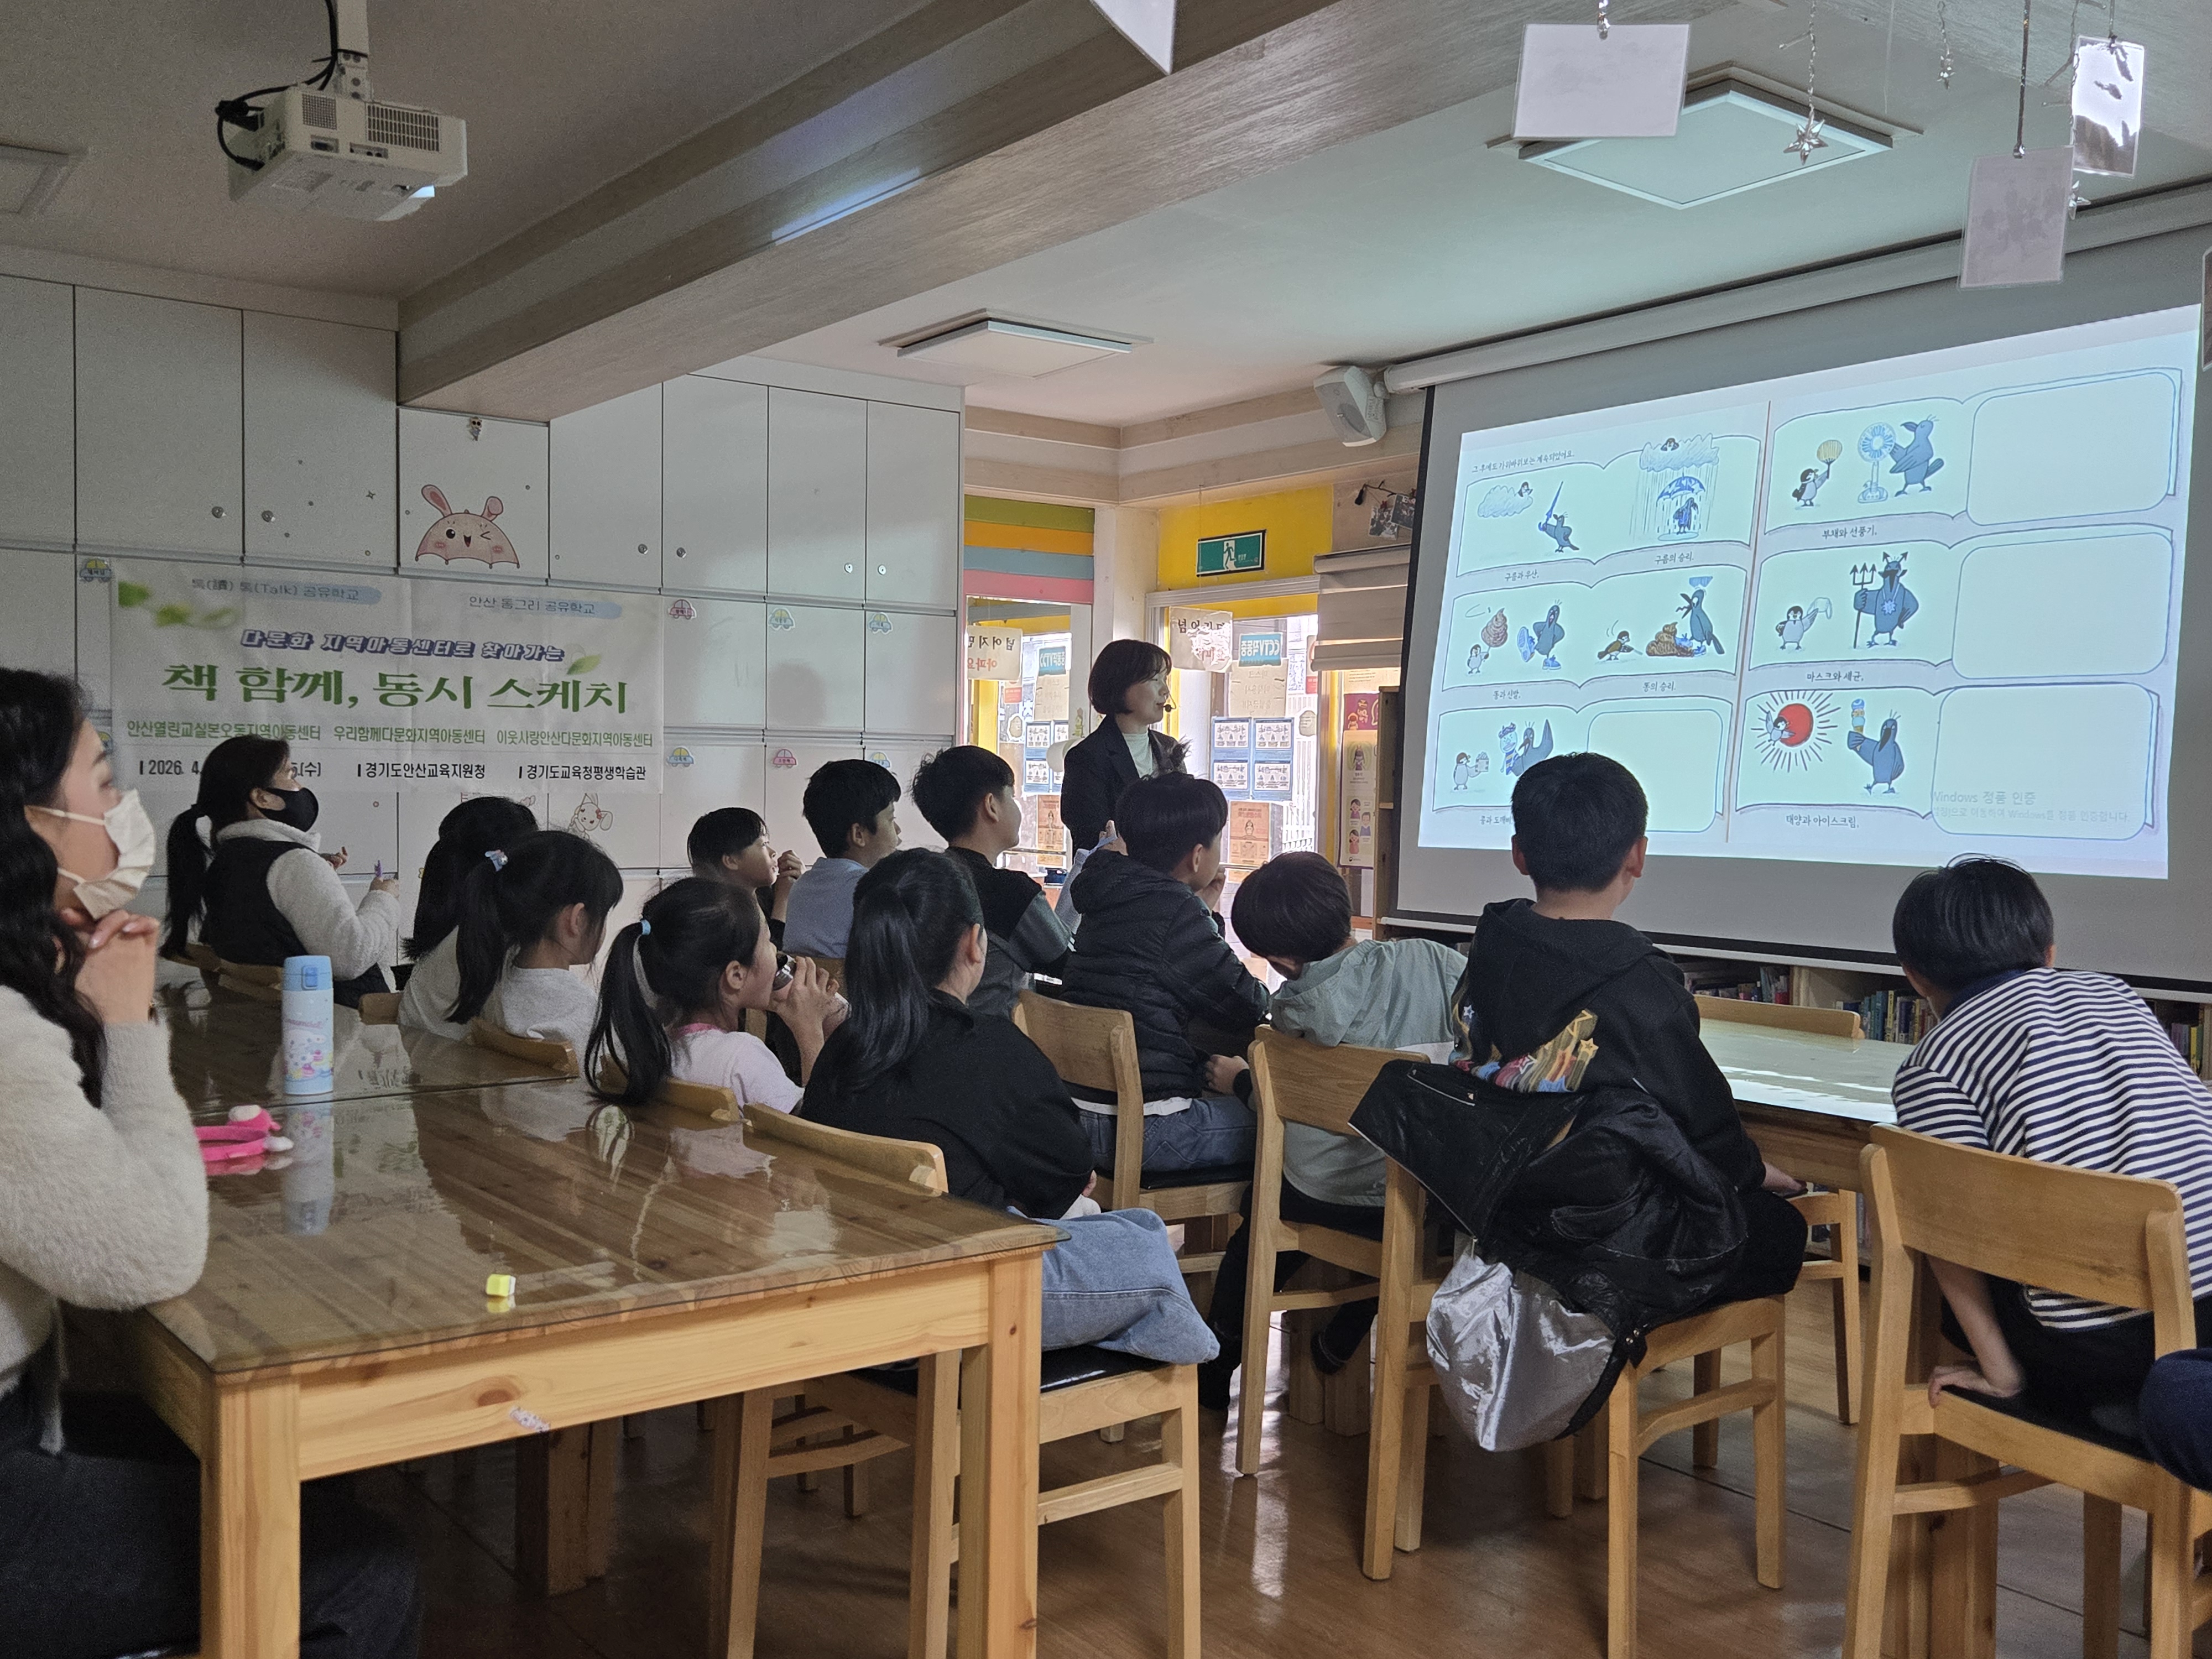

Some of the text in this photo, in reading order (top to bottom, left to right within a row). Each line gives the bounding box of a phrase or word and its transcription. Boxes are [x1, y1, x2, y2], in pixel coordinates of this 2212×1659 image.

[1499, 458, 1535, 470] 가위바위보는
[1822, 527, 1848, 540] 부채와
[1654, 551, 1694, 565] 구름의 승리.
[1505, 571, 1524, 581] 구름과
[304, 586, 359, 601] 공유학교
[469, 596, 497, 608] 안산
[545, 601, 595, 614] 공유학교
[241, 629, 565, 662] 다문화 지역아동센터로 찾아가는
[1807, 671, 1841, 682] 마스크와
[162, 664, 628, 713] 책 함께, 동시 스케치
[1660, 681, 1676, 692] 승리.
[333, 725, 486, 744] 우리함께다문화지역아동센터
[497, 729, 653, 748] 이웃사랑안산다문화지역아동센터
[148, 760, 184, 775] 2026.
[365, 761, 486, 779] 경기도안산교육지원청
[526, 764, 646, 781] 경기도교육청평생학습관
[1983, 791, 2007, 805] 정품
[2012, 792, 2036, 805] 인증
[1786, 814, 1811, 826] 태양과
[1970, 807, 2005, 818] 이동하여
[2008, 810, 2054, 821] Windows를
[2059, 810, 2077, 822] 정품
